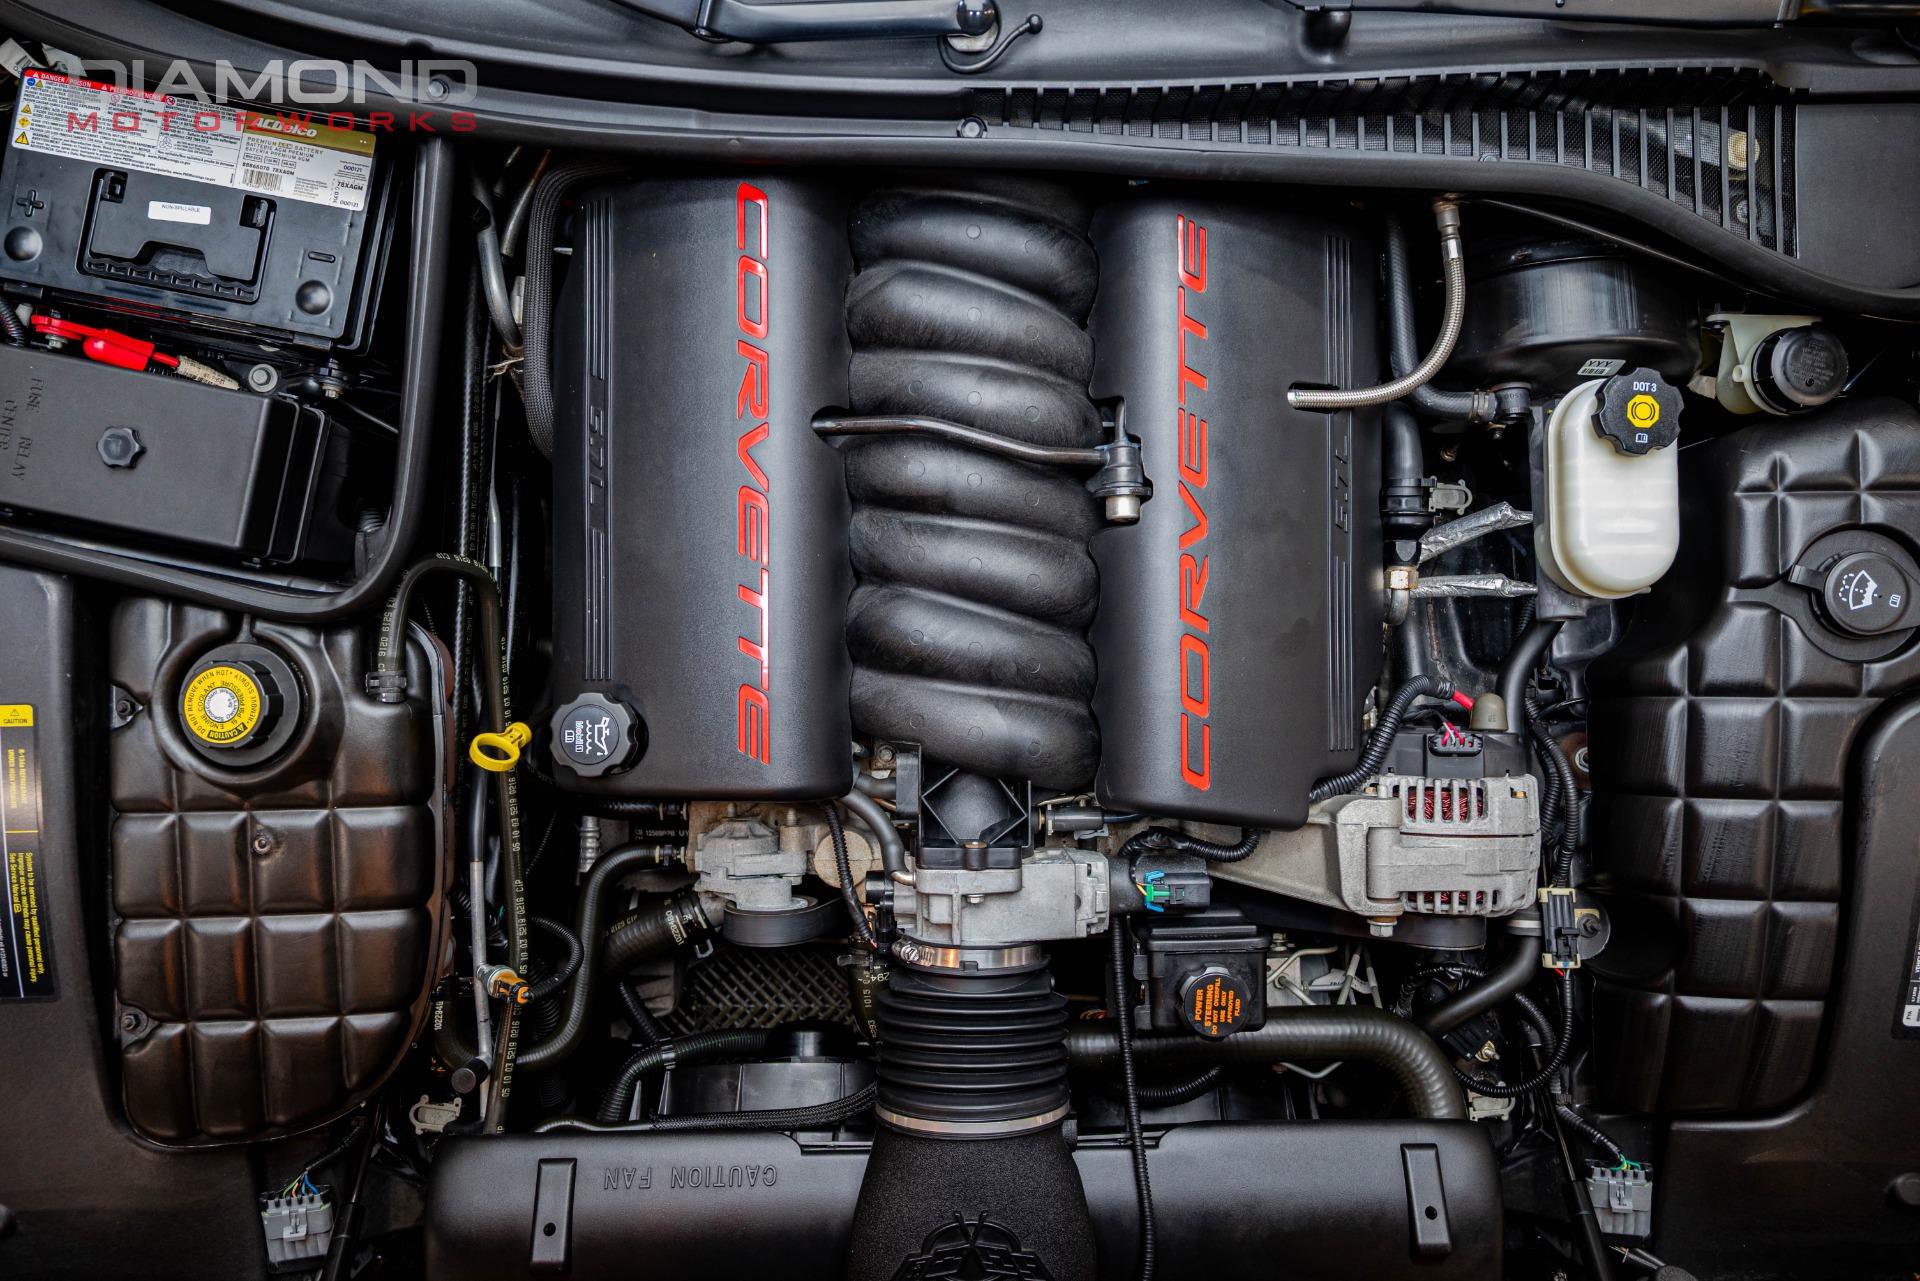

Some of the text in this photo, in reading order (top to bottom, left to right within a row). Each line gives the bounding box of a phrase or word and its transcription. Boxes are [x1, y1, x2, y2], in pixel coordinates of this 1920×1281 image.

[40, 72, 64, 82] DANGER
[337, 180, 363, 190] 78XAGM
[737, 182, 770, 765] CORVETTE
[1177, 213, 1211, 792] CORVETTE
[378, 637, 389, 657] 0216
[198, 681, 216, 712] COOLANT
[209, 729, 239, 739] CAUTION
[512, 830, 520, 838] 10
[519, 939, 527, 949] 03
[520, 952, 528, 960] 10
[520, 964, 528, 974] 05
[1195, 989, 1203, 1020] POWER
[1205, 984, 1214, 1026] STEERING
[510, 1020, 520, 1038] 0216
[1212, 1025, 1217, 1034] DO
[507, 1042, 517, 1059] 5219
[504, 1063, 514, 1072] 03
[503, 1076, 512, 1084] 10
[502, 1088, 510, 1097] 05
[603, 1164, 777, 1189] CAUTION FAN
